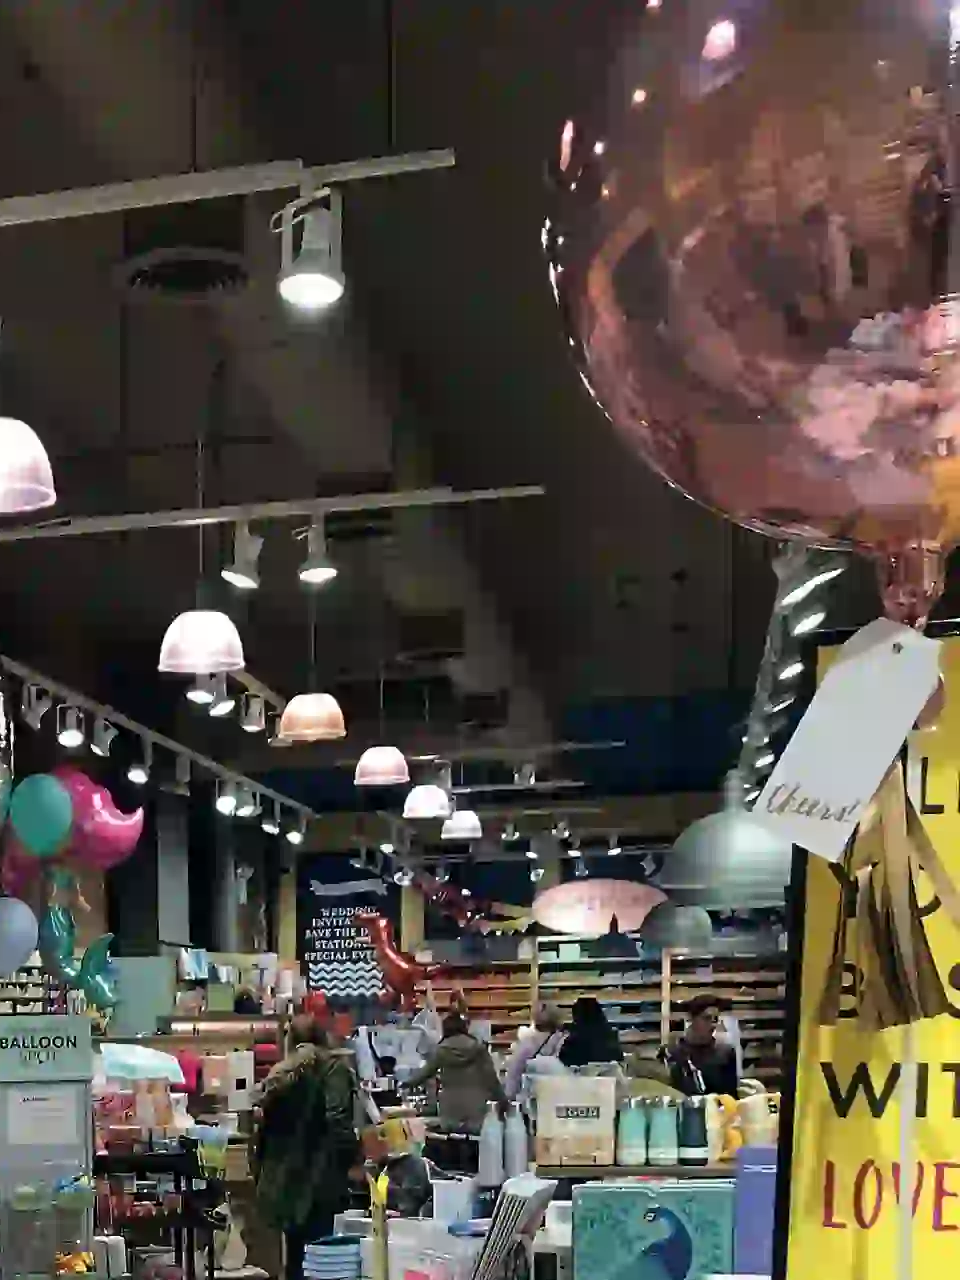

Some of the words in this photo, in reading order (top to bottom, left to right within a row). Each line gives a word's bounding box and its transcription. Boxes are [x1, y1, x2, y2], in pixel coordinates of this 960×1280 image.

[312, 918, 352, 927] INVITA
[0, 1035, 77, 1049] BALLOON
[822, 1158, 960, 1232] LOVE
